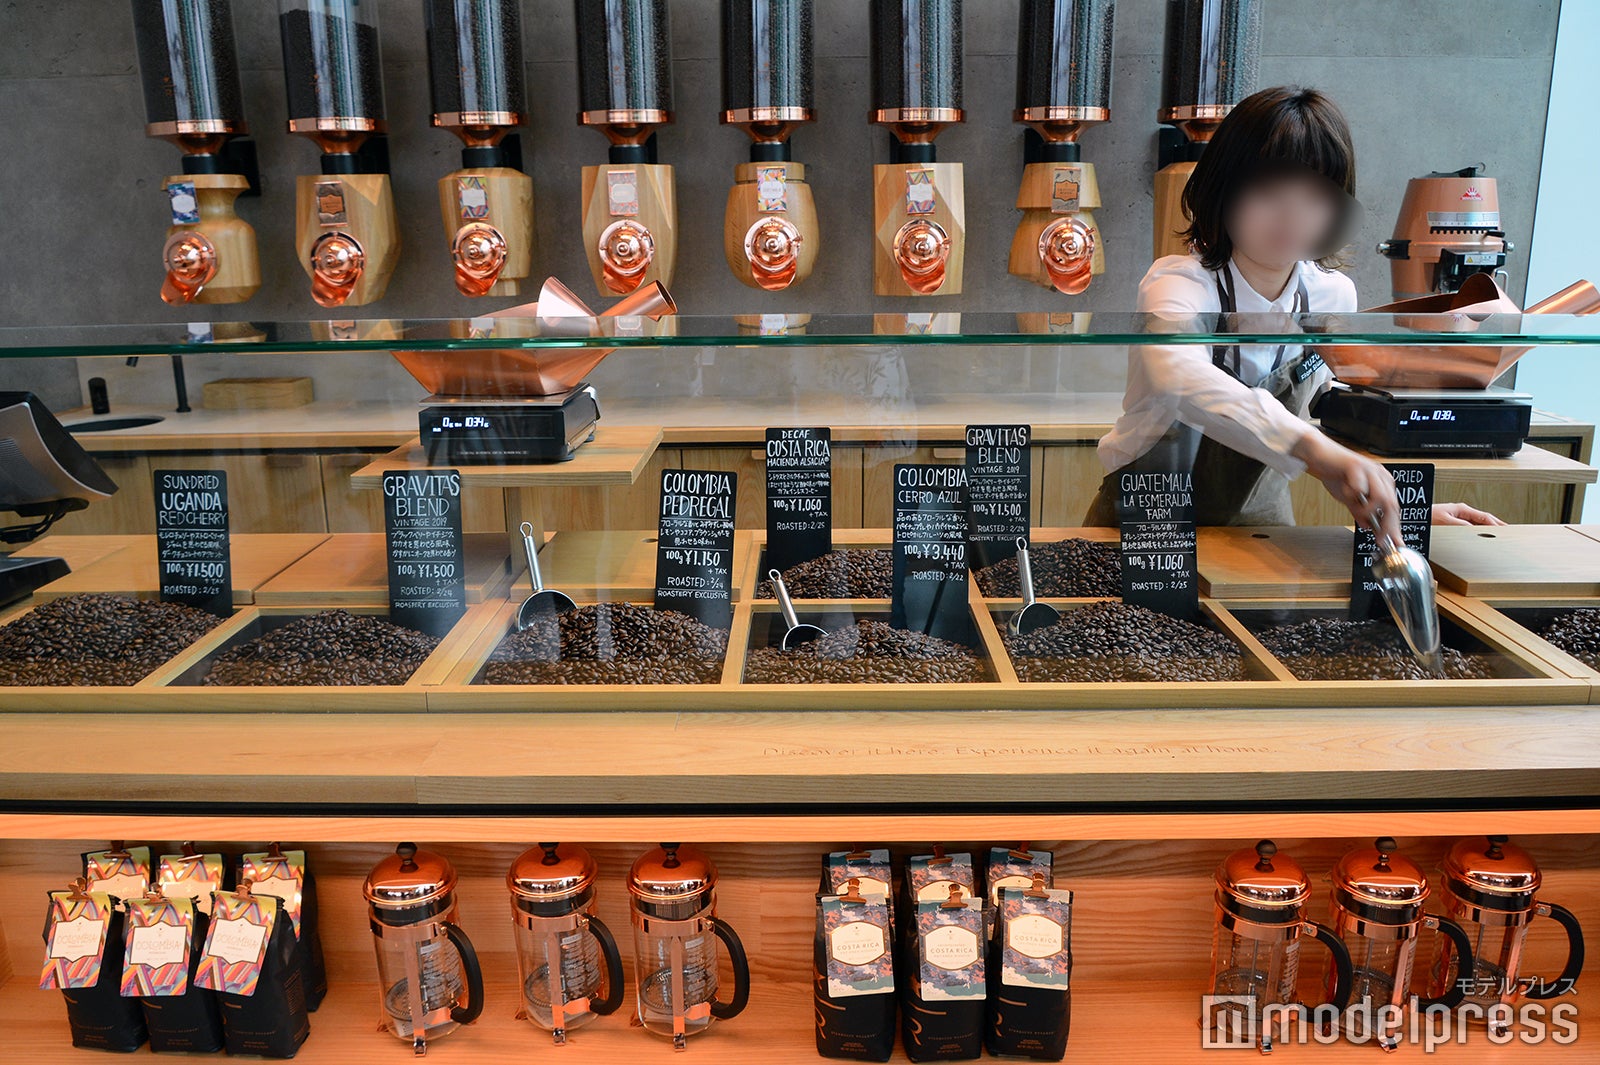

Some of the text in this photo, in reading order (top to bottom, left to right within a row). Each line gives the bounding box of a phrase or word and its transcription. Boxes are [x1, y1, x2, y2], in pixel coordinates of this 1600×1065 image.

[781, 430, 810, 439] DECAF
[966, 427, 1027, 447] GRAVITAS
[767, 440, 830, 457] COSTA RICA
[767, 457, 799, 467] HACIENDA
[978, 447, 1021, 465] BLEND
[971, 465, 1004, 474] VINTAGE
[663, 473, 732, 495] COLOMBIA
[898, 468, 969, 487] COLOMBIA
[1121, 473, 1194, 492] GUATEMALA
[383, 474, 460, 497] GRAVITAS
[161, 491, 223, 511] UGANDA
[898, 490, 962, 504] CERRO AZUL
[1122, 493, 1193, 508] LA ESMERALDA
[395, 498, 450, 517] BLEND
[662, 495, 732, 518] PEDREGAL
[773, 500, 789, 511] 100g
[972, 504, 989, 515] 100g
[1146, 508, 1173, 520] FARM
[393, 517, 448, 527] VINTAGE 2019
[665, 551, 684, 565] 100g
[903, 545, 921, 559] 100g
[166, 562, 186, 576] 100g
[1128, 556, 1146, 570] 100g
[397, 565, 417, 578] 100g
[1176, 570, 1191, 578] TAX
[657, 590, 729, 600] ROASTERY EXCLUSIVE
[955, 747, 1080, 758] Experience
[836, 943, 861, 951] COSTA
[1039, 936, 1058, 944] RICA
